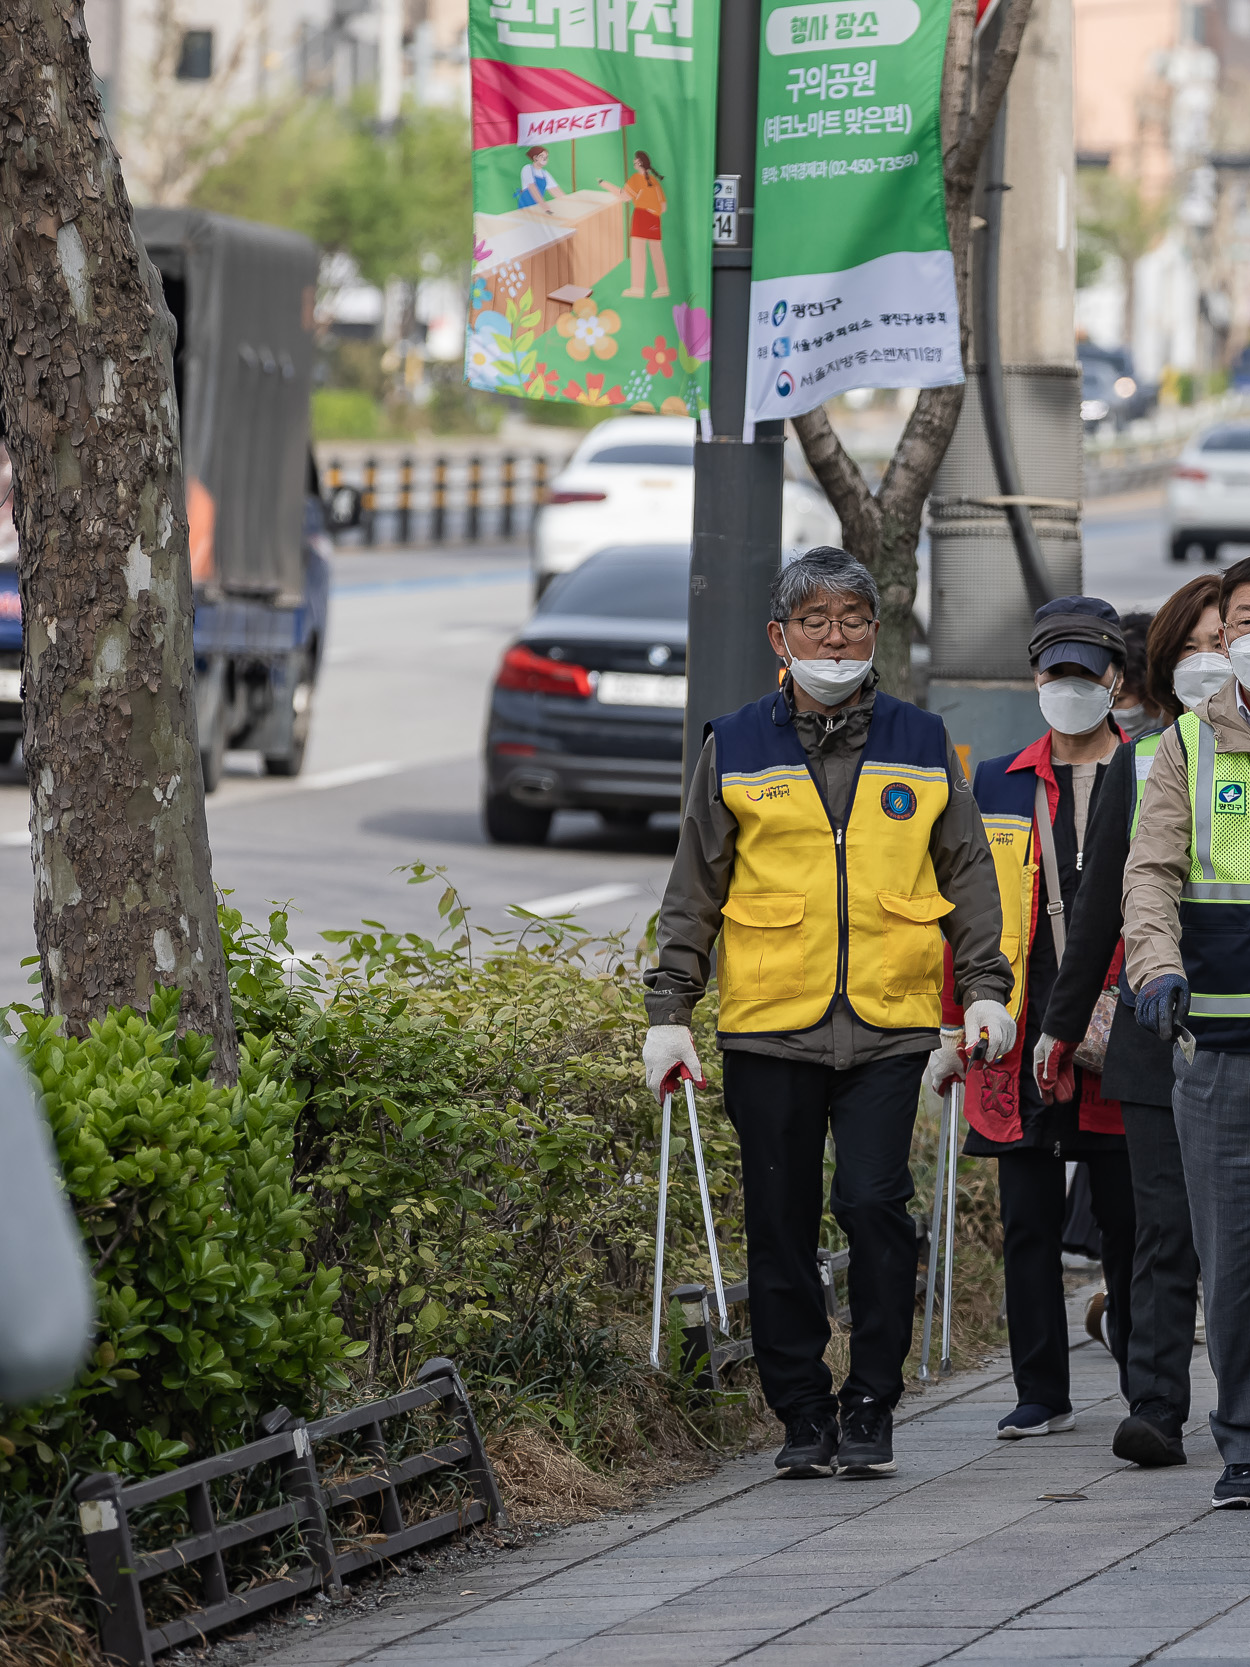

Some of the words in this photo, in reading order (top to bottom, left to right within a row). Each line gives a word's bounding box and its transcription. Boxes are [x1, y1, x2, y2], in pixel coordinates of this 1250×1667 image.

[790, 16, 828, 45] 행사
[835, 11, 879, 40] 장소
[785, 59, 877, 104] 구의공원
[526, 108, 614, 138] MARKET
[763, 110, 842, 147] (테크노마트
[843, 103, 912, 135] 맞은편)
[829, 150, 919, 179] (02-450-7359)
[791, 297, 843, 319] 광진구
[1218, 803, 1243, 811] 광진구
